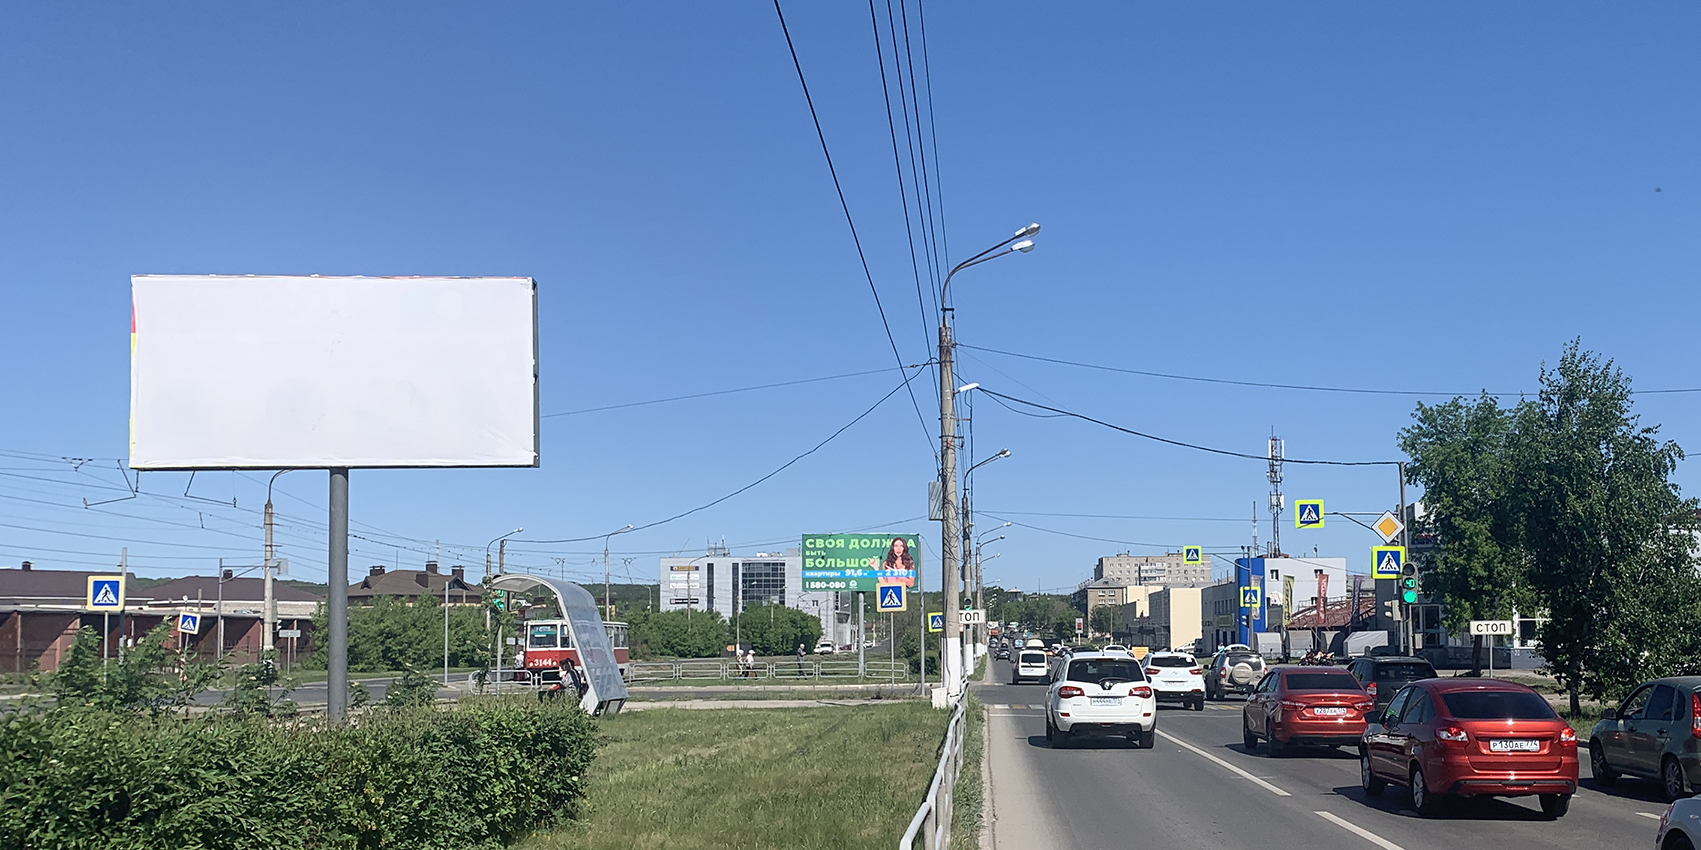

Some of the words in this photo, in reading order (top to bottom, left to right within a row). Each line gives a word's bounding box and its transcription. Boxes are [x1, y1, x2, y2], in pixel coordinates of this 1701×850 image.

[805, 538, 845, 548] СВОЯ
[848, 538, 916, 550] ДОЛЖА
[845, 568, 864, 577] 91,6
[1405, 579, 1415, 588] 40
[958, 612, 980, 622] ТОП
[1476, 623, 1506, 633] СТОП
[534, 658, 552, 667] 3144
